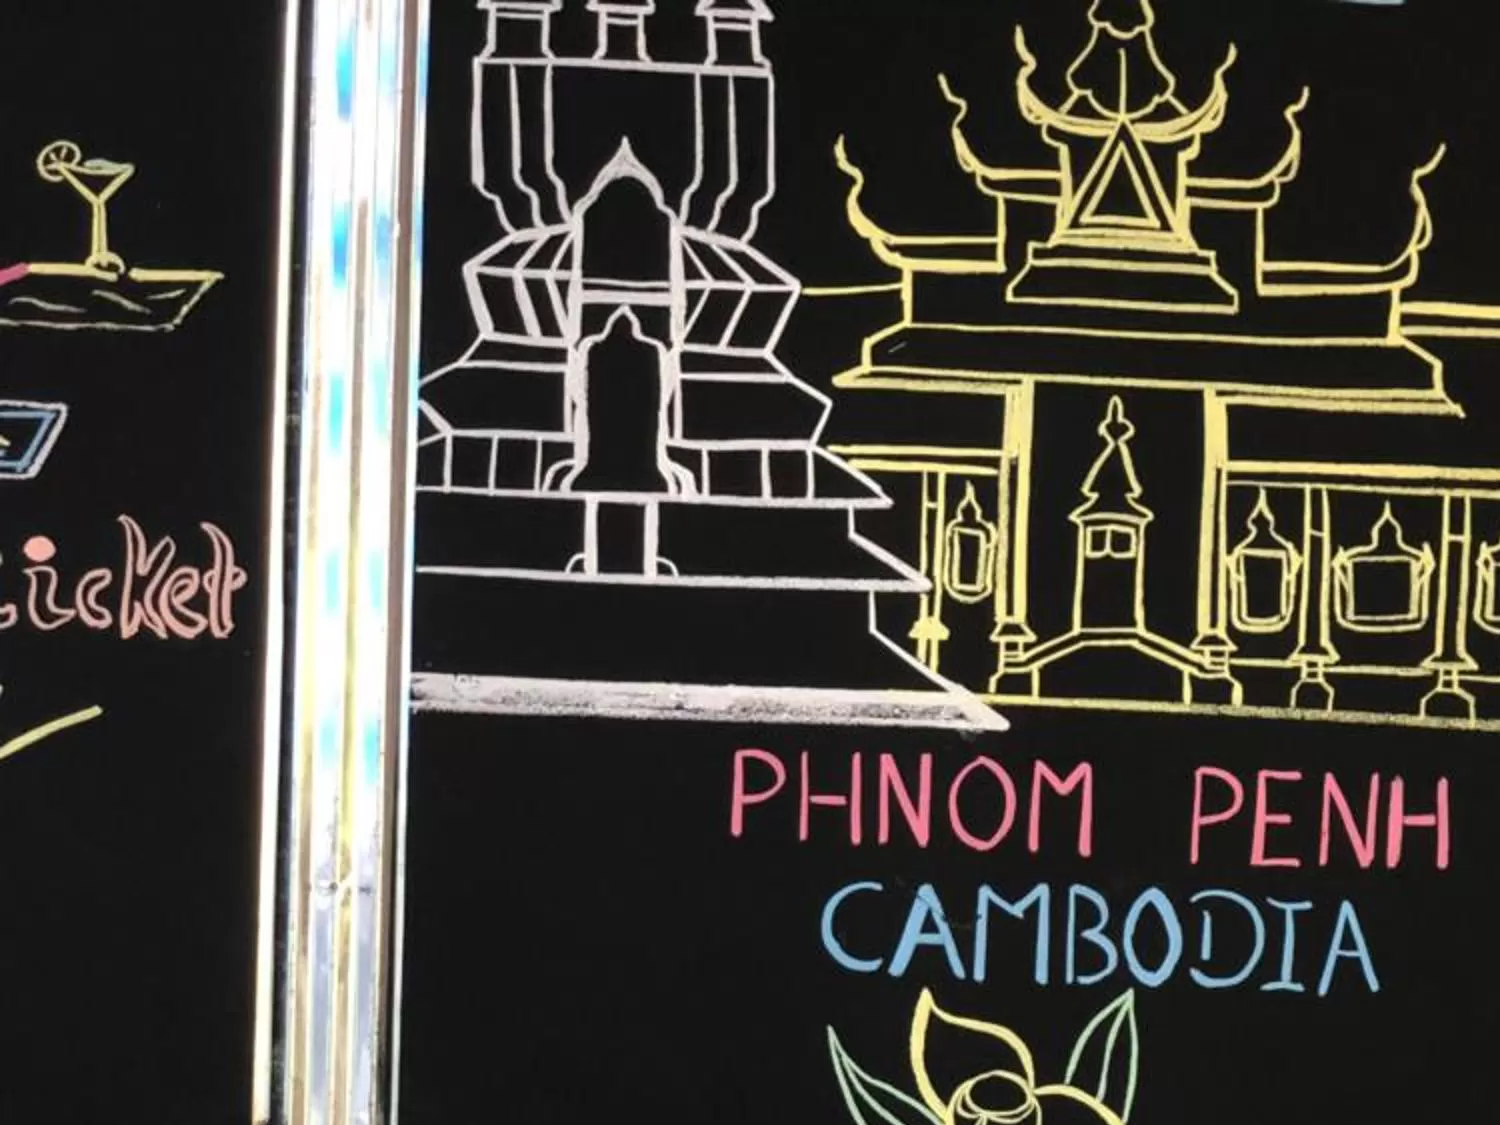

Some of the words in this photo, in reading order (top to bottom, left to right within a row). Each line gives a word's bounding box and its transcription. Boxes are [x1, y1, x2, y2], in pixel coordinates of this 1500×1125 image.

[0, 514, 247, 639] icket
[731, 749, 1092, 857] PHNOM
[1190, 766, 1449, 869] PENH
[821, 882, 1379, 996] CAMBODIA
